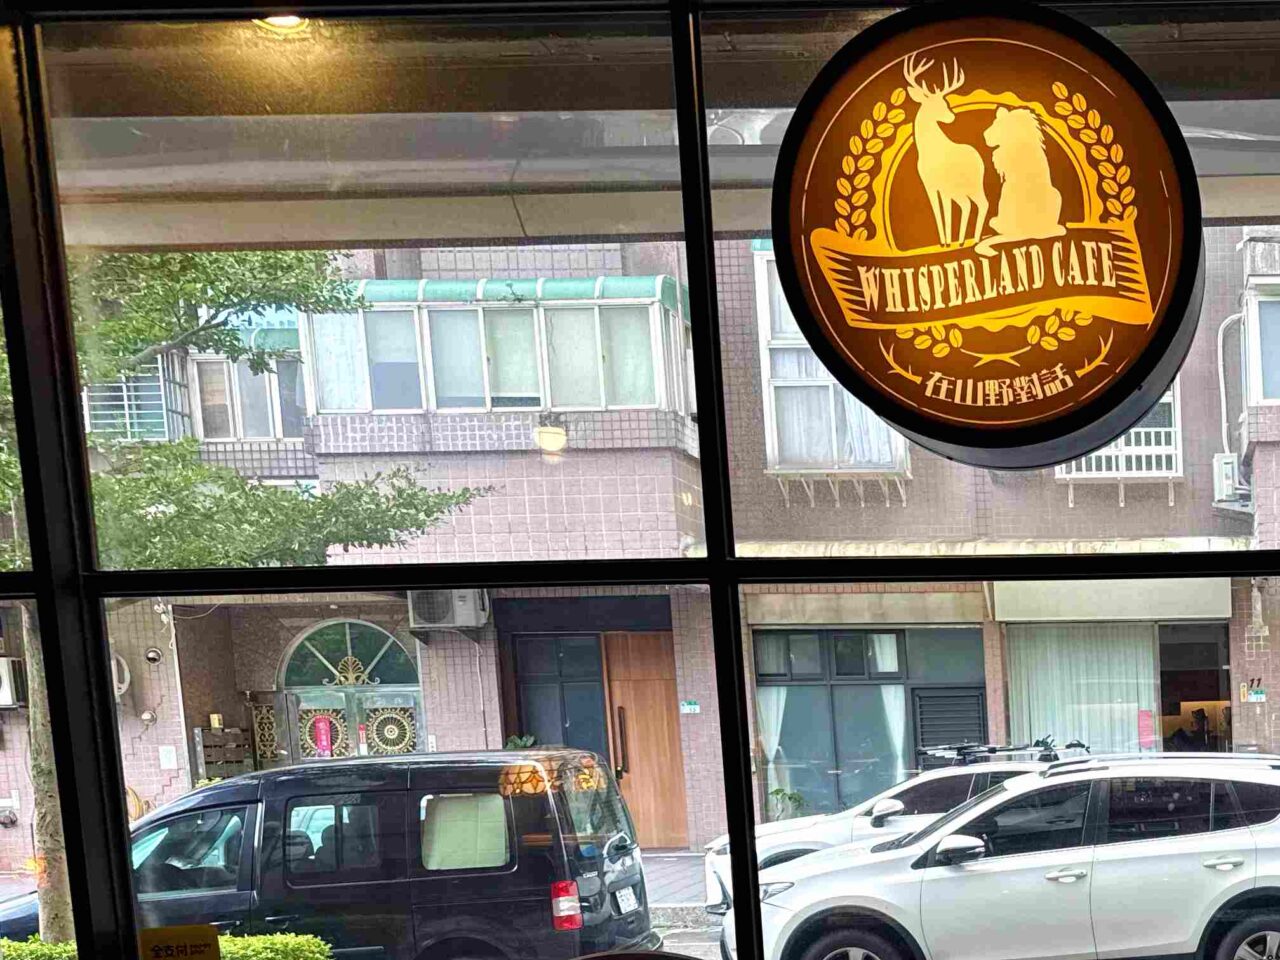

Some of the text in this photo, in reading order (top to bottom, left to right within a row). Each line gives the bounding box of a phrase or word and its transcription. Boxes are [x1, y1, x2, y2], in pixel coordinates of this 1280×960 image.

[856, 240, 1117, 313] WHISPERLAND CAFE
[924, 362, 1075, 407] 在山野對話
[1249, 678, 1262, 689] 11
